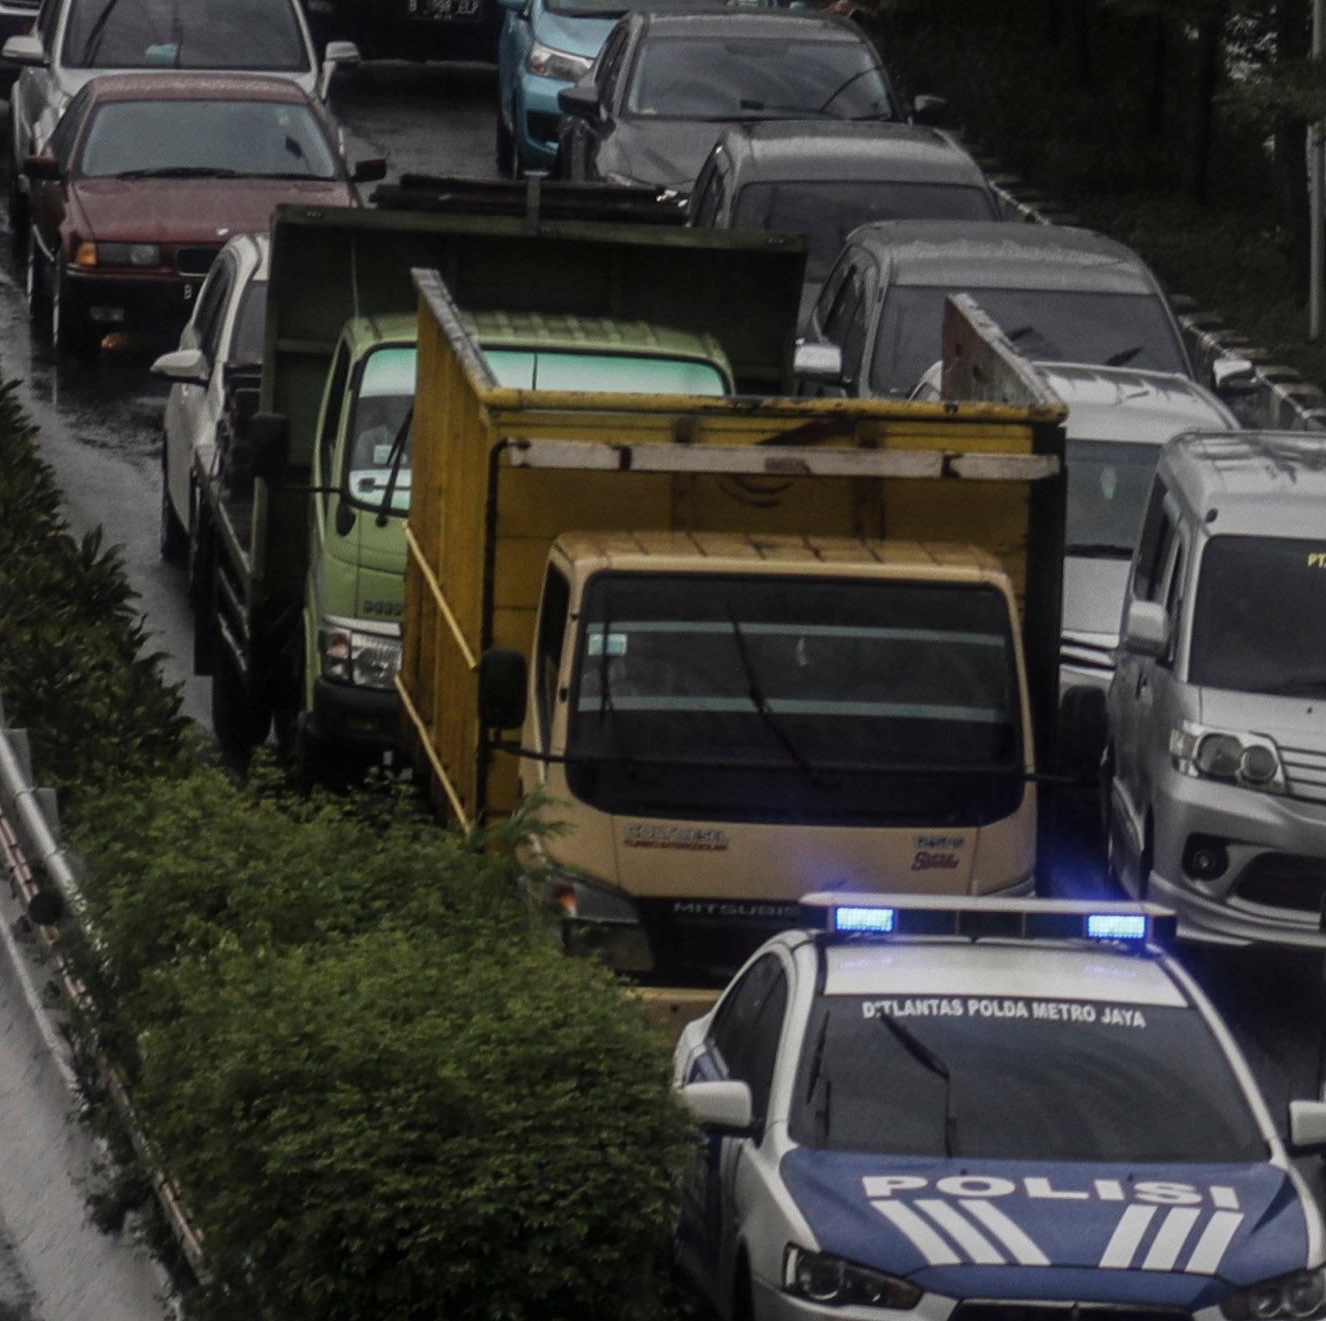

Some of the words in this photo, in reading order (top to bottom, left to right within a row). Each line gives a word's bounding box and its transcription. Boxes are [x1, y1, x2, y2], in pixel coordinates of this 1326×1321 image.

[968, 999, 1028, 1019] POLDA
[1032, 1002, 1097, 1024] METRO
[1100, 1007, 1147, 1029] JAYA
[861, 1175, 1240, 1210] POLISI
